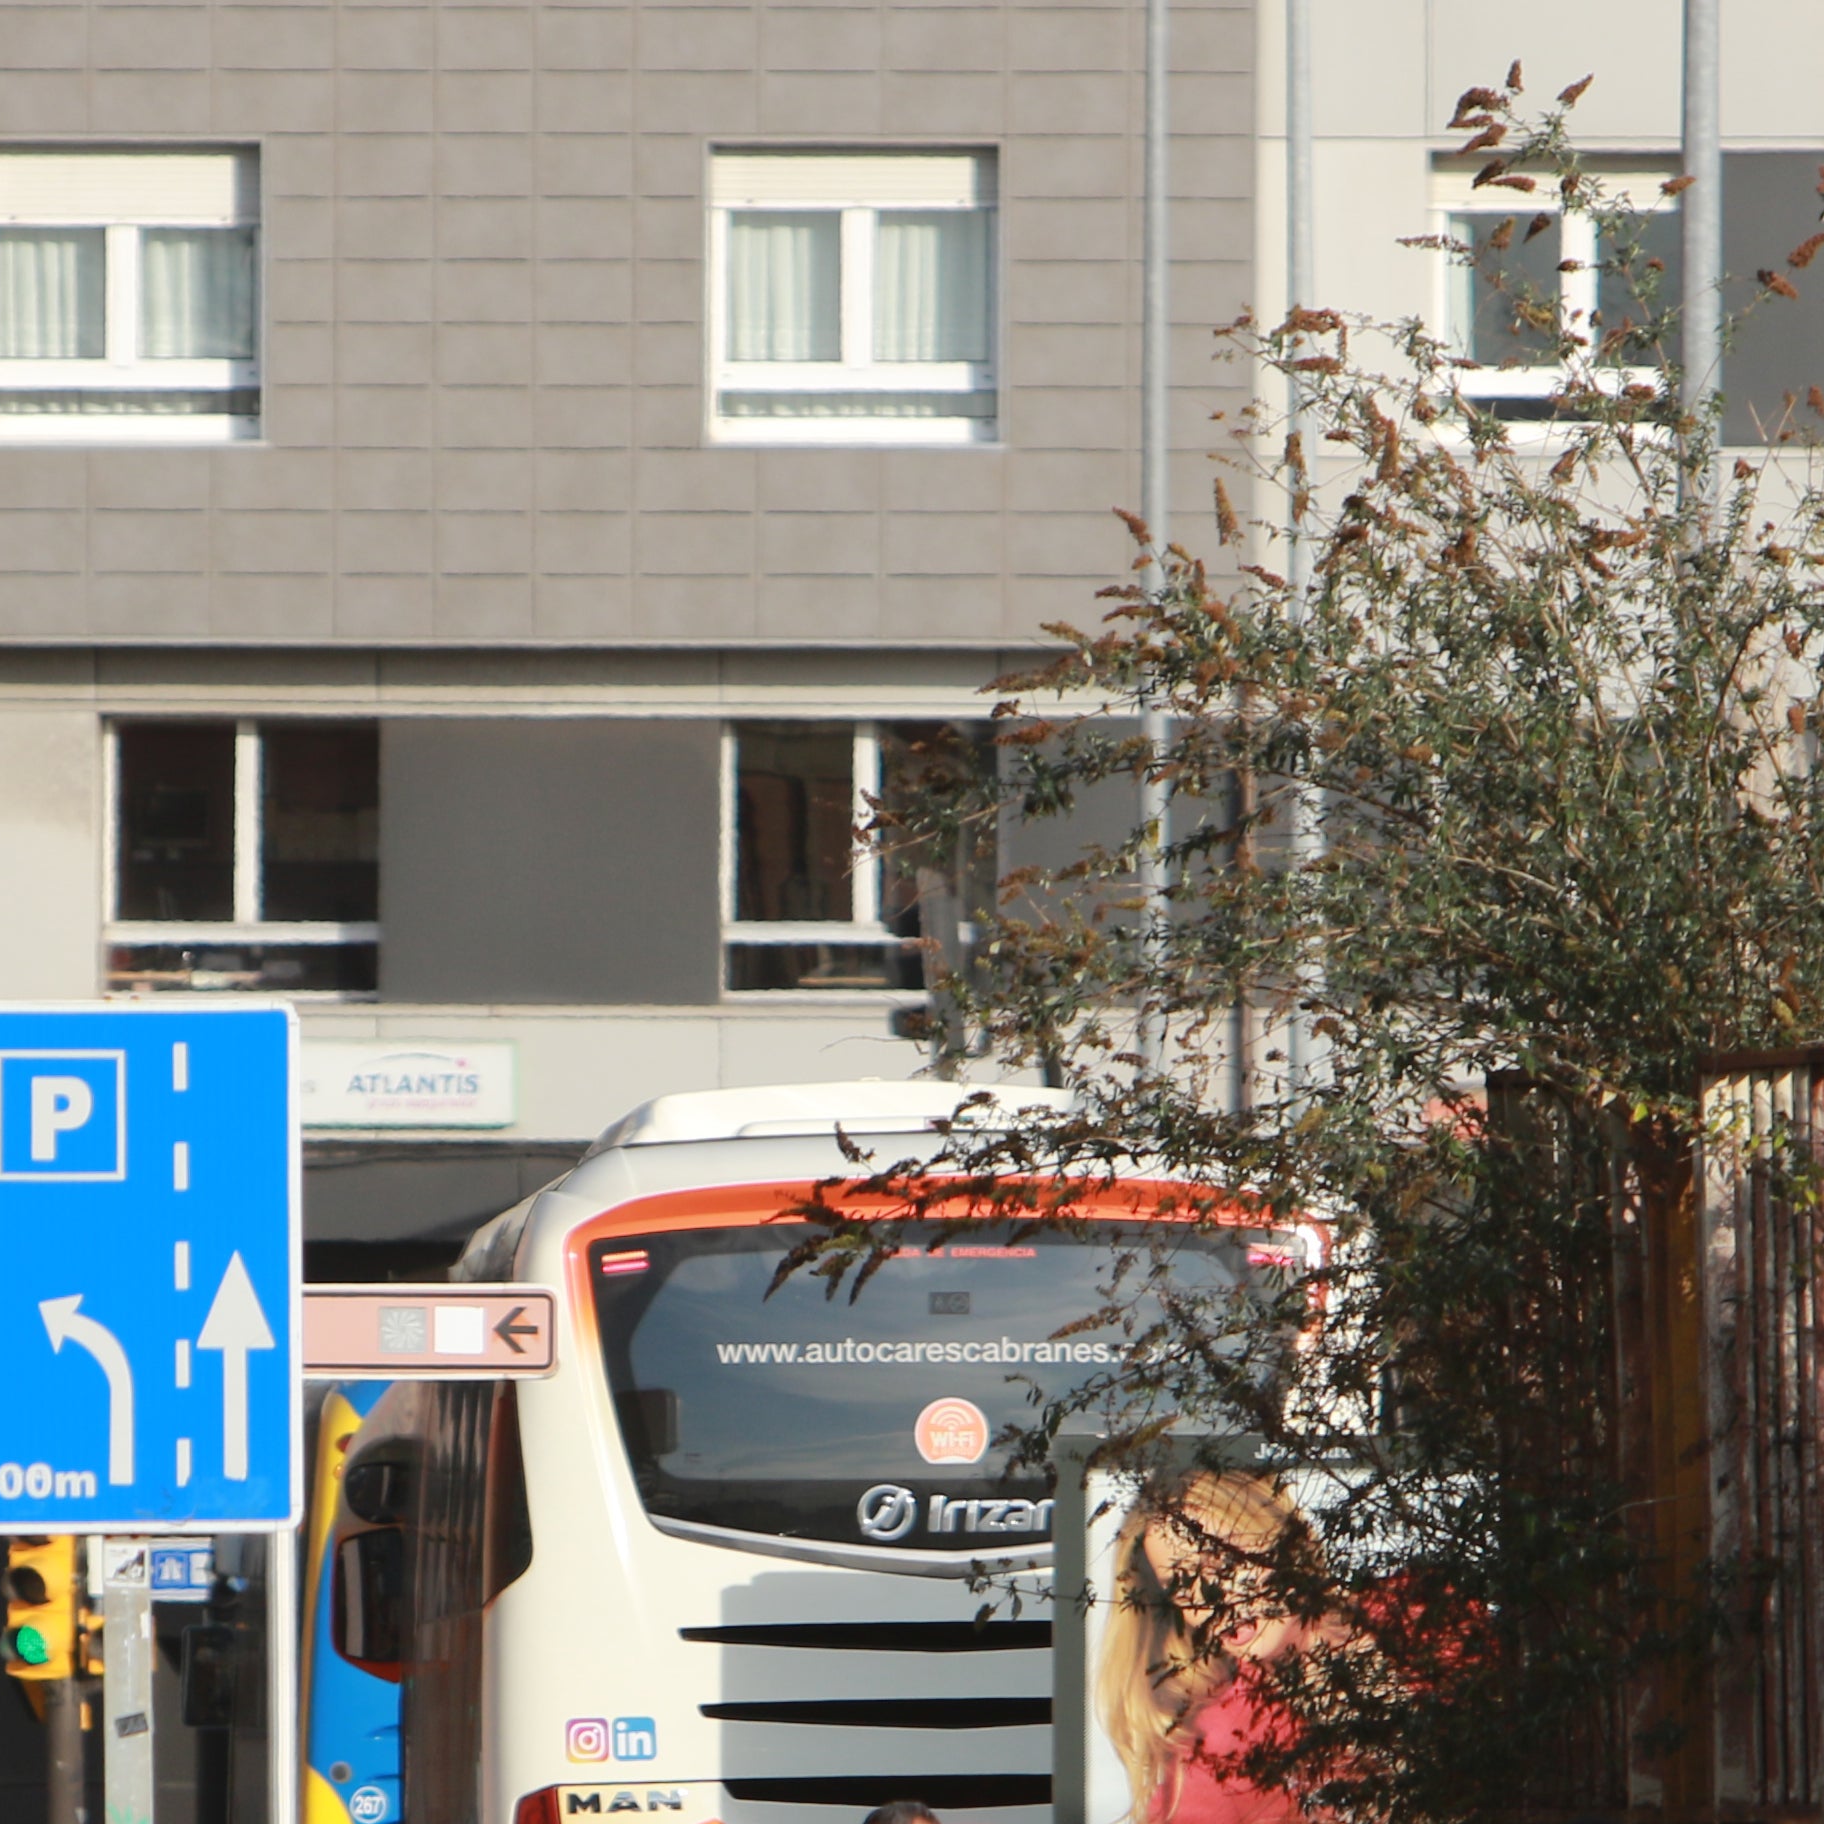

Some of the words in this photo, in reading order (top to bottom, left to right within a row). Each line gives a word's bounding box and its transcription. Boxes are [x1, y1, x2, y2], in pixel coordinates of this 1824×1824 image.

[345, 1074, 480, 1095] ATLANTIS
[30, 1075, 93, 1162] P
[951, 1247, 1037, 1258] EMERGENCIA
[616, 1720, 652, 1757] in
[354, 1795, 384, 1815] 267
[567, 1789, 683, 1814] MAN
